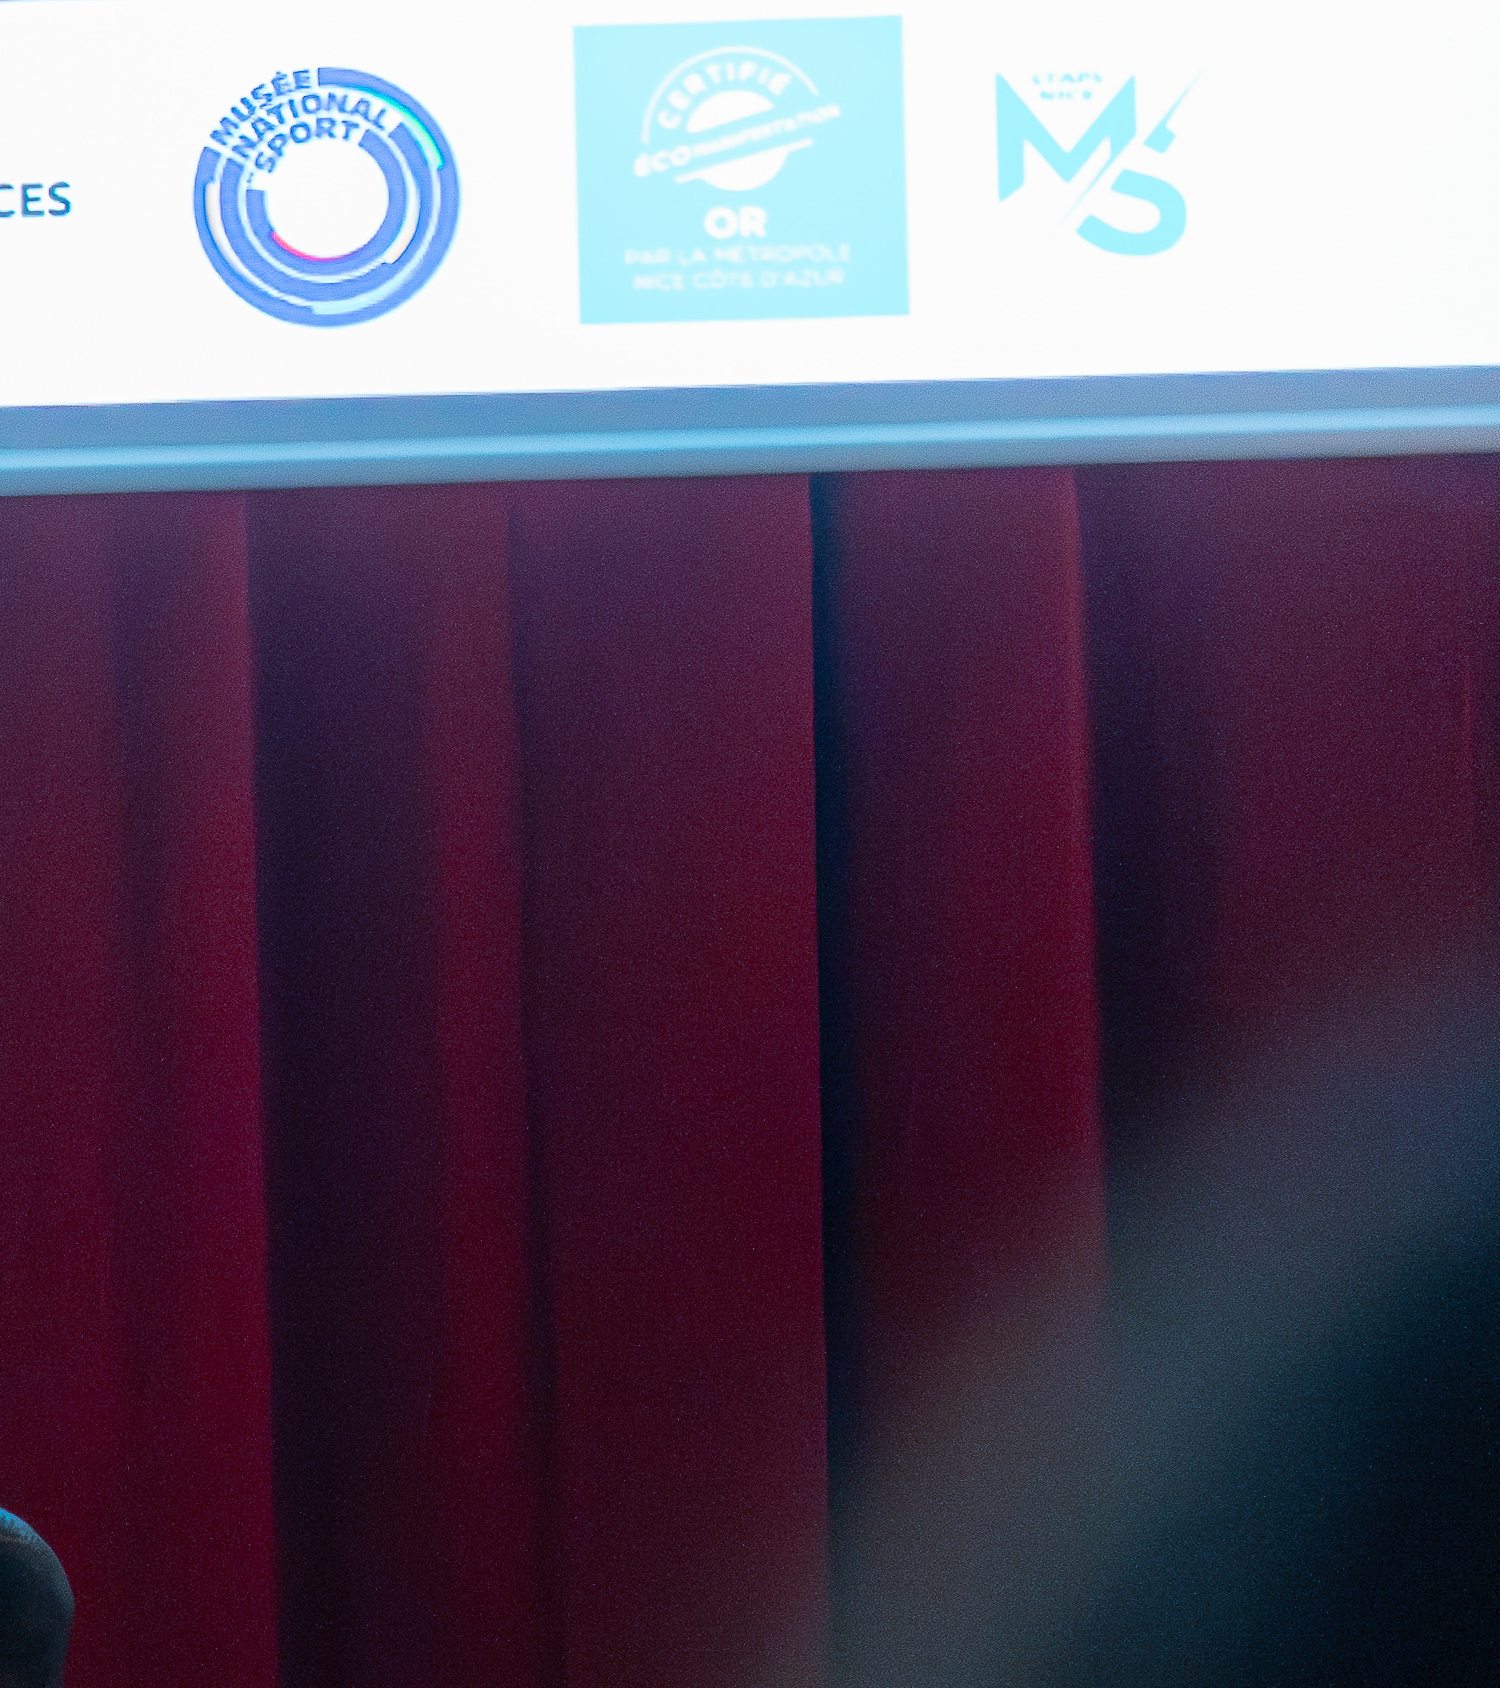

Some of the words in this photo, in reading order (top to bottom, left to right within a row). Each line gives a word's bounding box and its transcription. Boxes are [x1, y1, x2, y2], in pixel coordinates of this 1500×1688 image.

[209, 70, 313, 146] MUSÉE
[231, 92, 388, 160] NATIONAL
[254, 116, 360, 174] SPORT
[704, 205, 769, 240] OR
